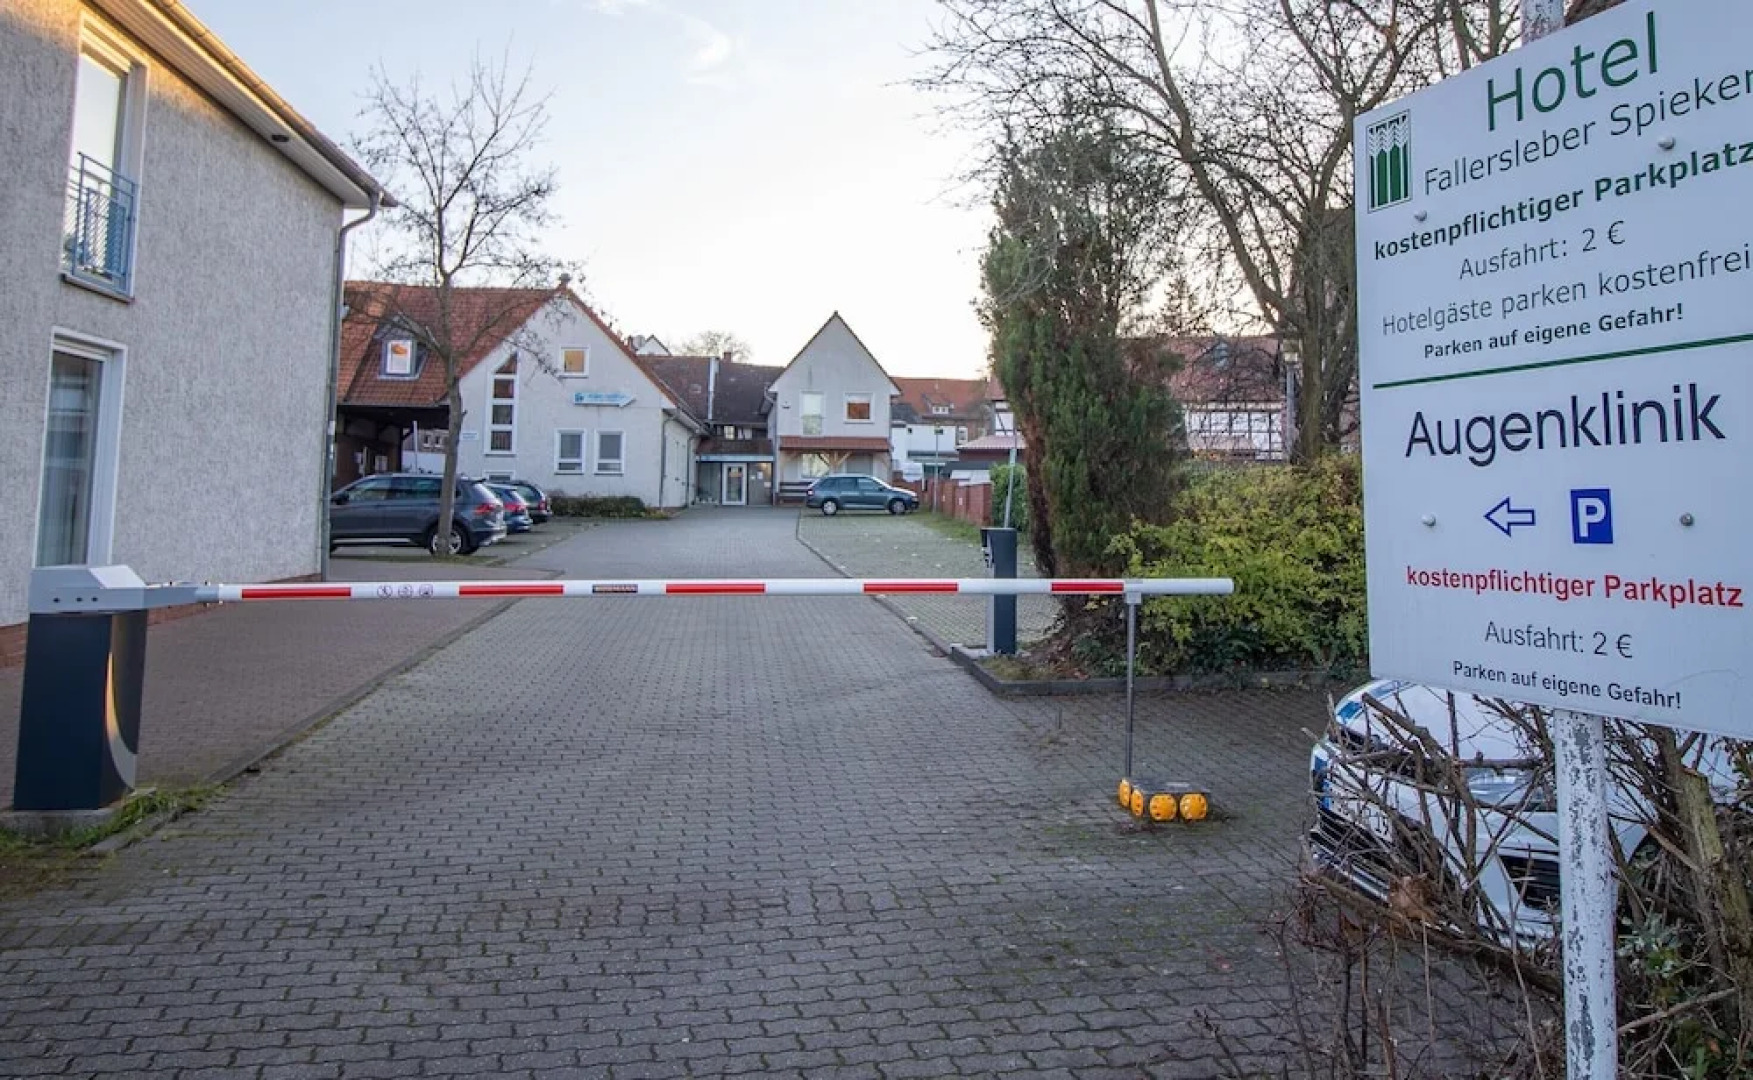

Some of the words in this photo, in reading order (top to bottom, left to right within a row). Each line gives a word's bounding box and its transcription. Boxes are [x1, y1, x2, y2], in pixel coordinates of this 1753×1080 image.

[1487, 11, 1658, 132] Hotel
[1425, 120, 1596, 196] Fallersleber
[1374, 190, 1583, 260] kostenpflichtiger
[1594, 141, 1753, 202] Parkplatz
[1459, 237, 1568, 279] Ausfahrt:
[1582, 228, 1597, 252] 2
[1608, 221, 1626, 245] €
[1383, 298, 1492, 337] Hotelgäste
[1501, 280, 1587, 319] parken
[1599, 244, 1750, 296] kostenfrei
[1424, 336, 1483, 358] Parken
[1488, 330, 1517, 350] auf
[1523, 323, 1592, 345] eigene
[1598, 303, 1683, 332] Gefahr!
[1405, 383, 1726, 466] Augenklinik
[1577, 497, 1607, 537] P
[1406, 566, 1596, 601] kostenpflichtiger
[1605, 574, 1744, 608] Parkplatz
[1485, 621, 1584, 653] Ausfahrt:
[1593, 632, 1608, 656] 2
[1616, 634, 1634, 658] €
[1453, 661, 1507, 683] Parken
[1511, 670, 1537, 688] auf
[1542, 674, 1601, 698] eigene
[1608, 683, 1681, 708] Gefahr!
